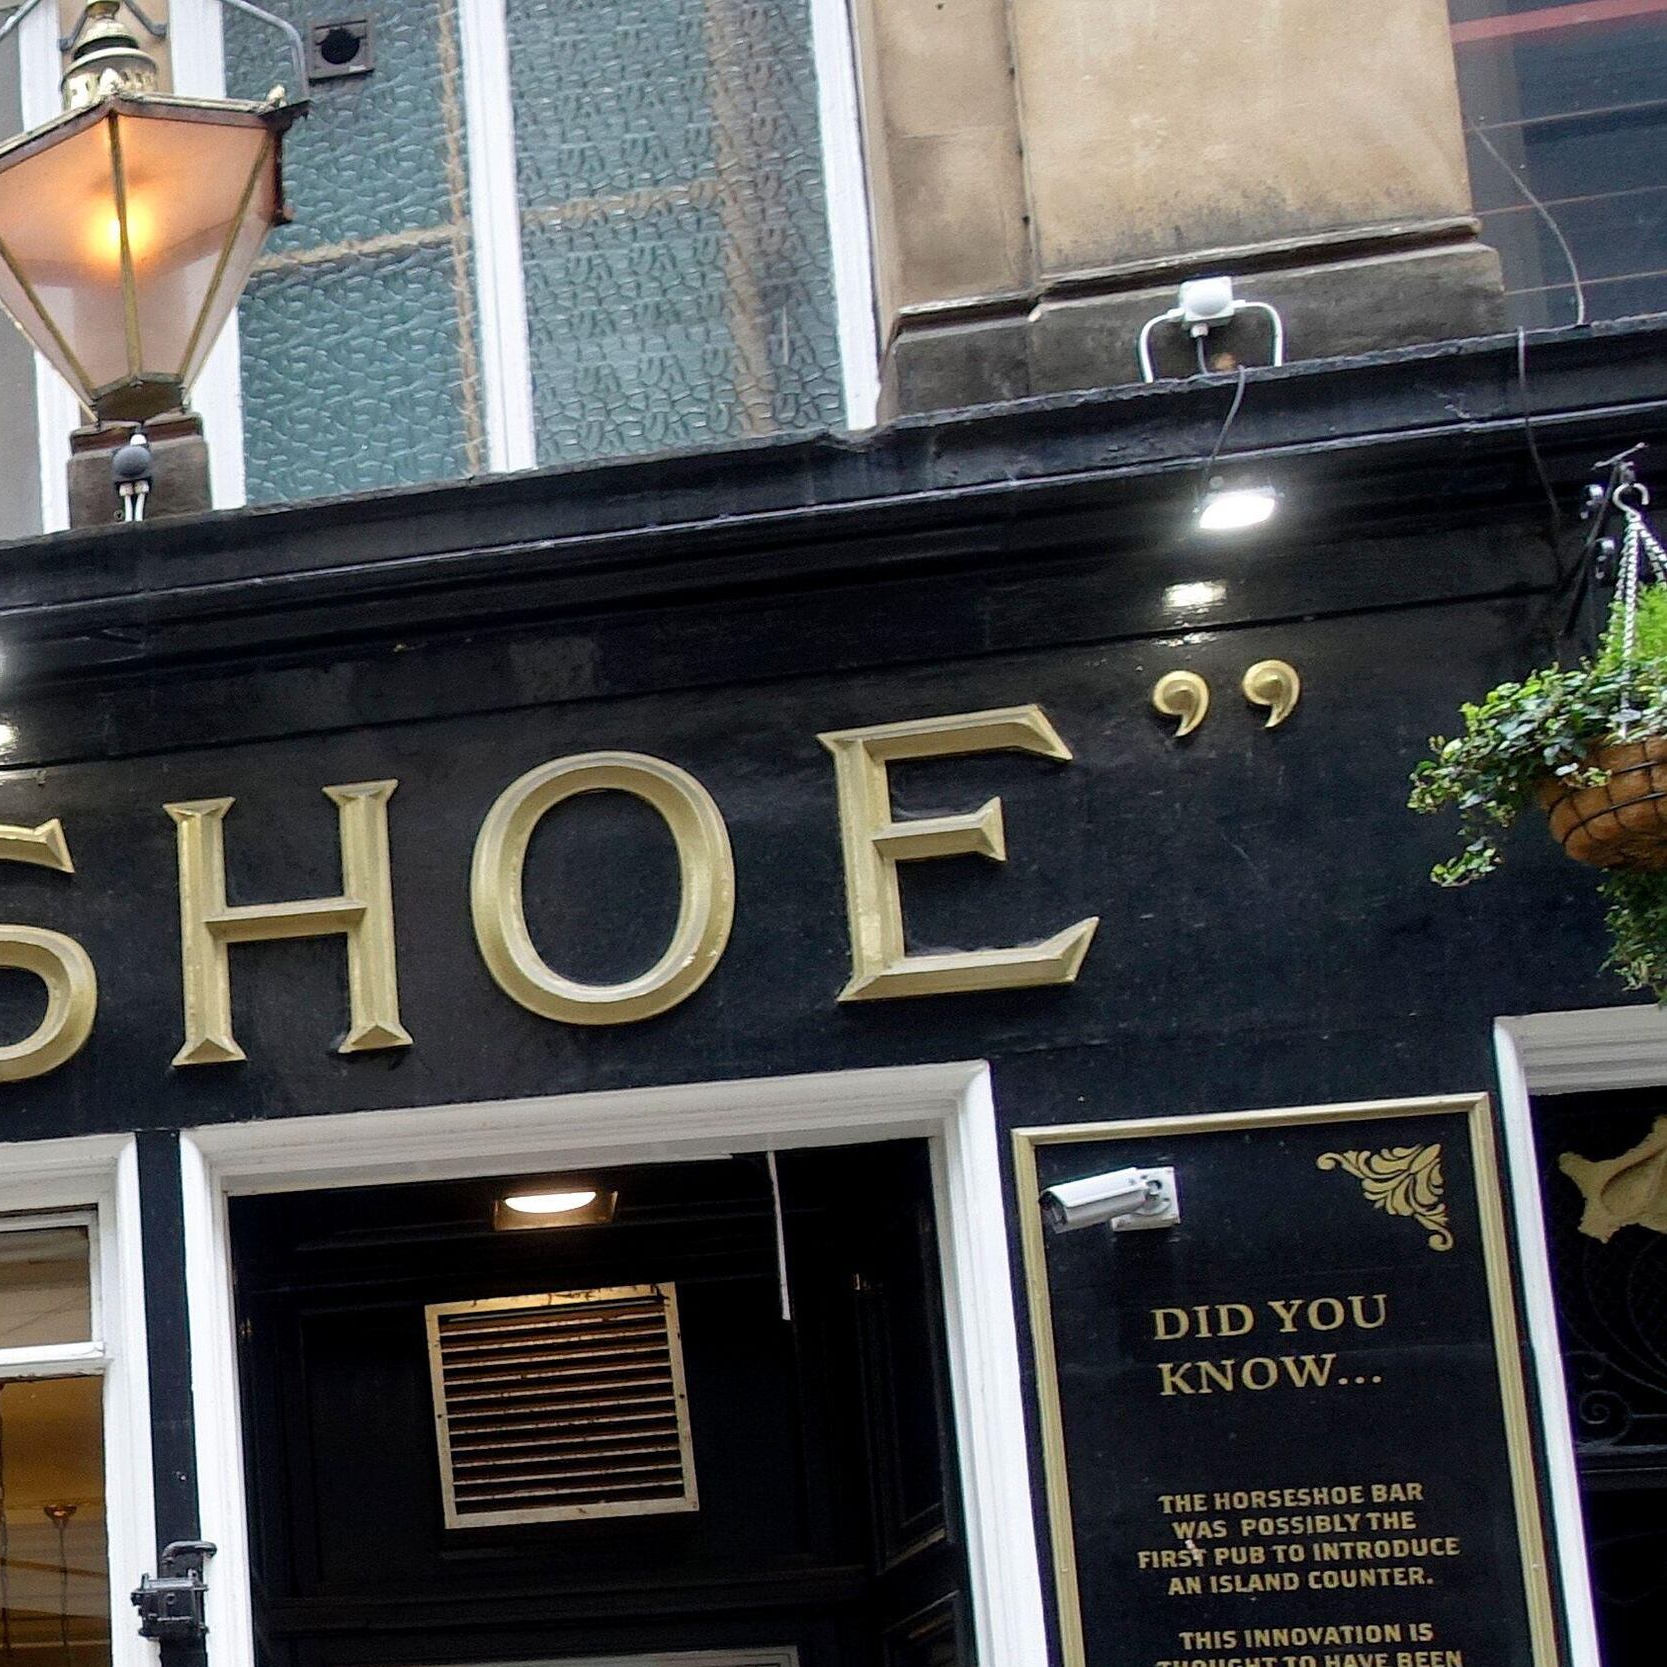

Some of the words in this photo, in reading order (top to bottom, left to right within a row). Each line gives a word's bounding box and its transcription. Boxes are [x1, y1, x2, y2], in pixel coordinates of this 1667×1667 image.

[1151, 1303, 1254, 1340] DID
[1267, 1294, 1387, 1333] YOU
[1158, 1493, 1208, 1514] THE
[1213, 1485, 1365, 1510] HORSESHOE
[1371, 1482, 1424, 1503] BAR
[1171, 1519, 1227, 1540] WAS
[1240, 1513, 1361, 1537] POSSIBLY
[1365, 1511, 1417, 1531] THE
[1137, 1541, 1207, 1569] FIRST
[1214, 1546, 1265, 1566] PUB
[1272, 1544, 1305, 1563] TO
[1312, 1537, 1460, 1561] INTRODUCE
[1168, 1576, 1202, 1596] AN
[1209, 1572, 1300, 1594] ISLAND
[1308, 1566, 1434, 1589] COUNTER.
[1178, 1630, 1237, 1650] THIS
[1244, 1623, 1402, 1648] INNOVATION
[1408, 1622, 1434, 1642] IS
